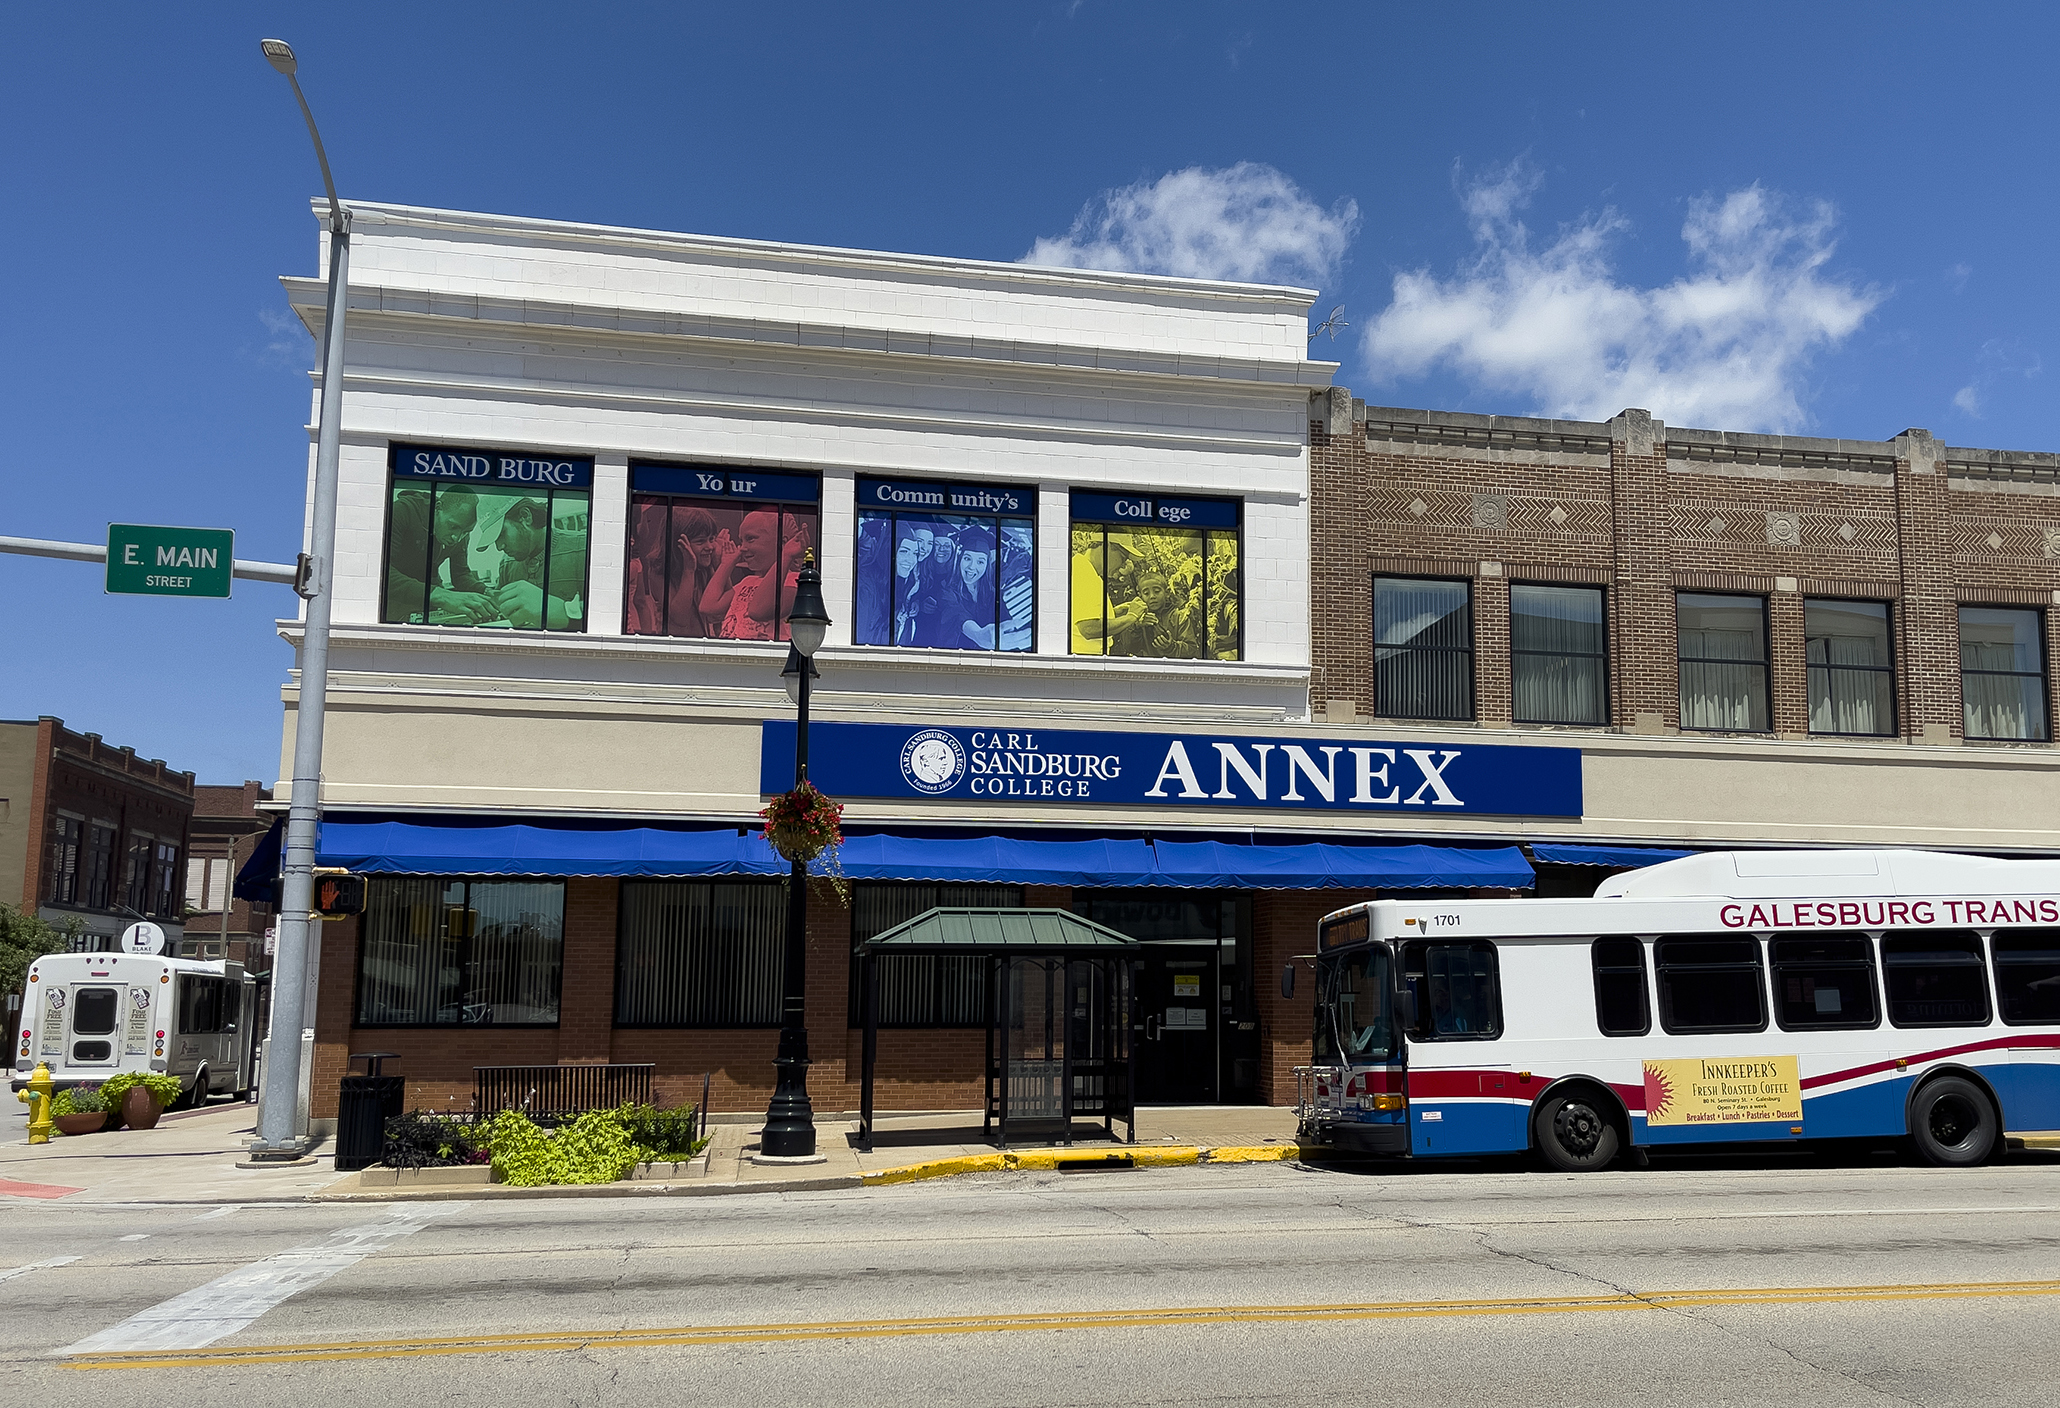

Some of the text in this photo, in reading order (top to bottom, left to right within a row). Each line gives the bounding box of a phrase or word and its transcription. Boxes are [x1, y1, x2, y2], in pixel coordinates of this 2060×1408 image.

[124, 543, 218, 569] E. MAIN
[145, 574, 193, 588] STREET
[971, 732, 1038, 750] CARL
[903, 732, 964, 776] CARL SANDBURG COLLEGE
[970, 751, 1122, 781] SANDBURG
[1144, 740, 1465, 806] ANNEX
[970, 777, 1090, 797] COLLEGE
[1433, 914, 1462, 926] 1701
[1719, 900, 2059, 928] GALESBURG TRANS
[1701, 1059, 1777, 1080] INNKEEPER'S
[1692, 1081, 1789, 1096] FRESH ROASTED COFFEE
[1686, 1109, 1799, 1122] Breakfast Lunch Pastries Dessert
